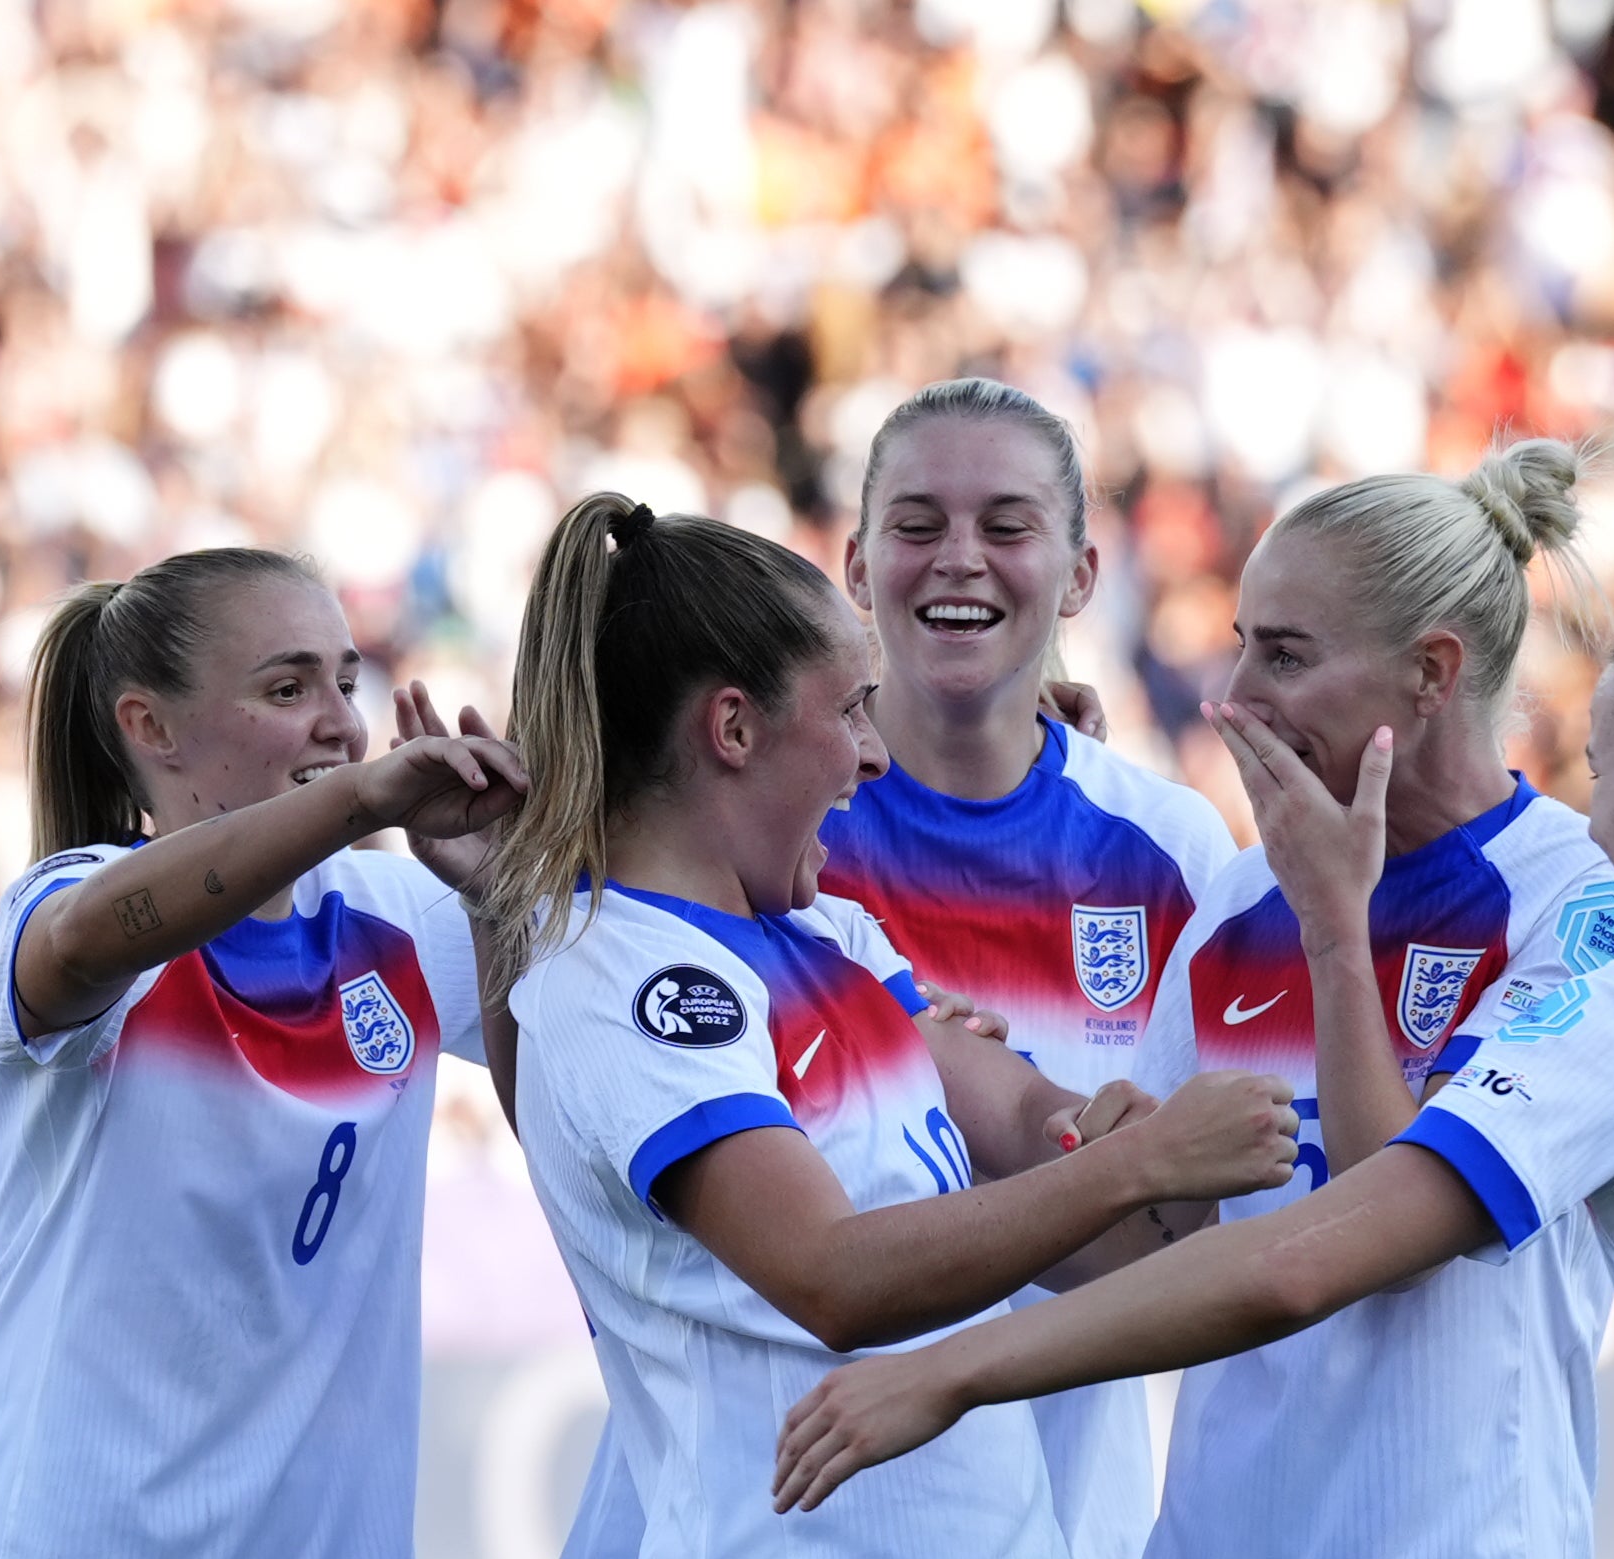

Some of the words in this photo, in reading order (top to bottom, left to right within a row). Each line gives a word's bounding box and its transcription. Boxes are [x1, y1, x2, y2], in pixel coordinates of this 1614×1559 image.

[1598, 911, 1614, 927] We
[688, 985, 719, 998] UEFA
[1509, 978, 1533, 992] UEFA
[680, 998, 734, 1008] EUROPEAN
[679, 1006, 739, 1017] CHAMPIONS
[696, 1015, 730, 1026] 2022
[1091, 1033, 1111, 1045] JULY
[1113, 1034, 1135, 1046] 2025
[291, 1121, 357, 1267] 8
